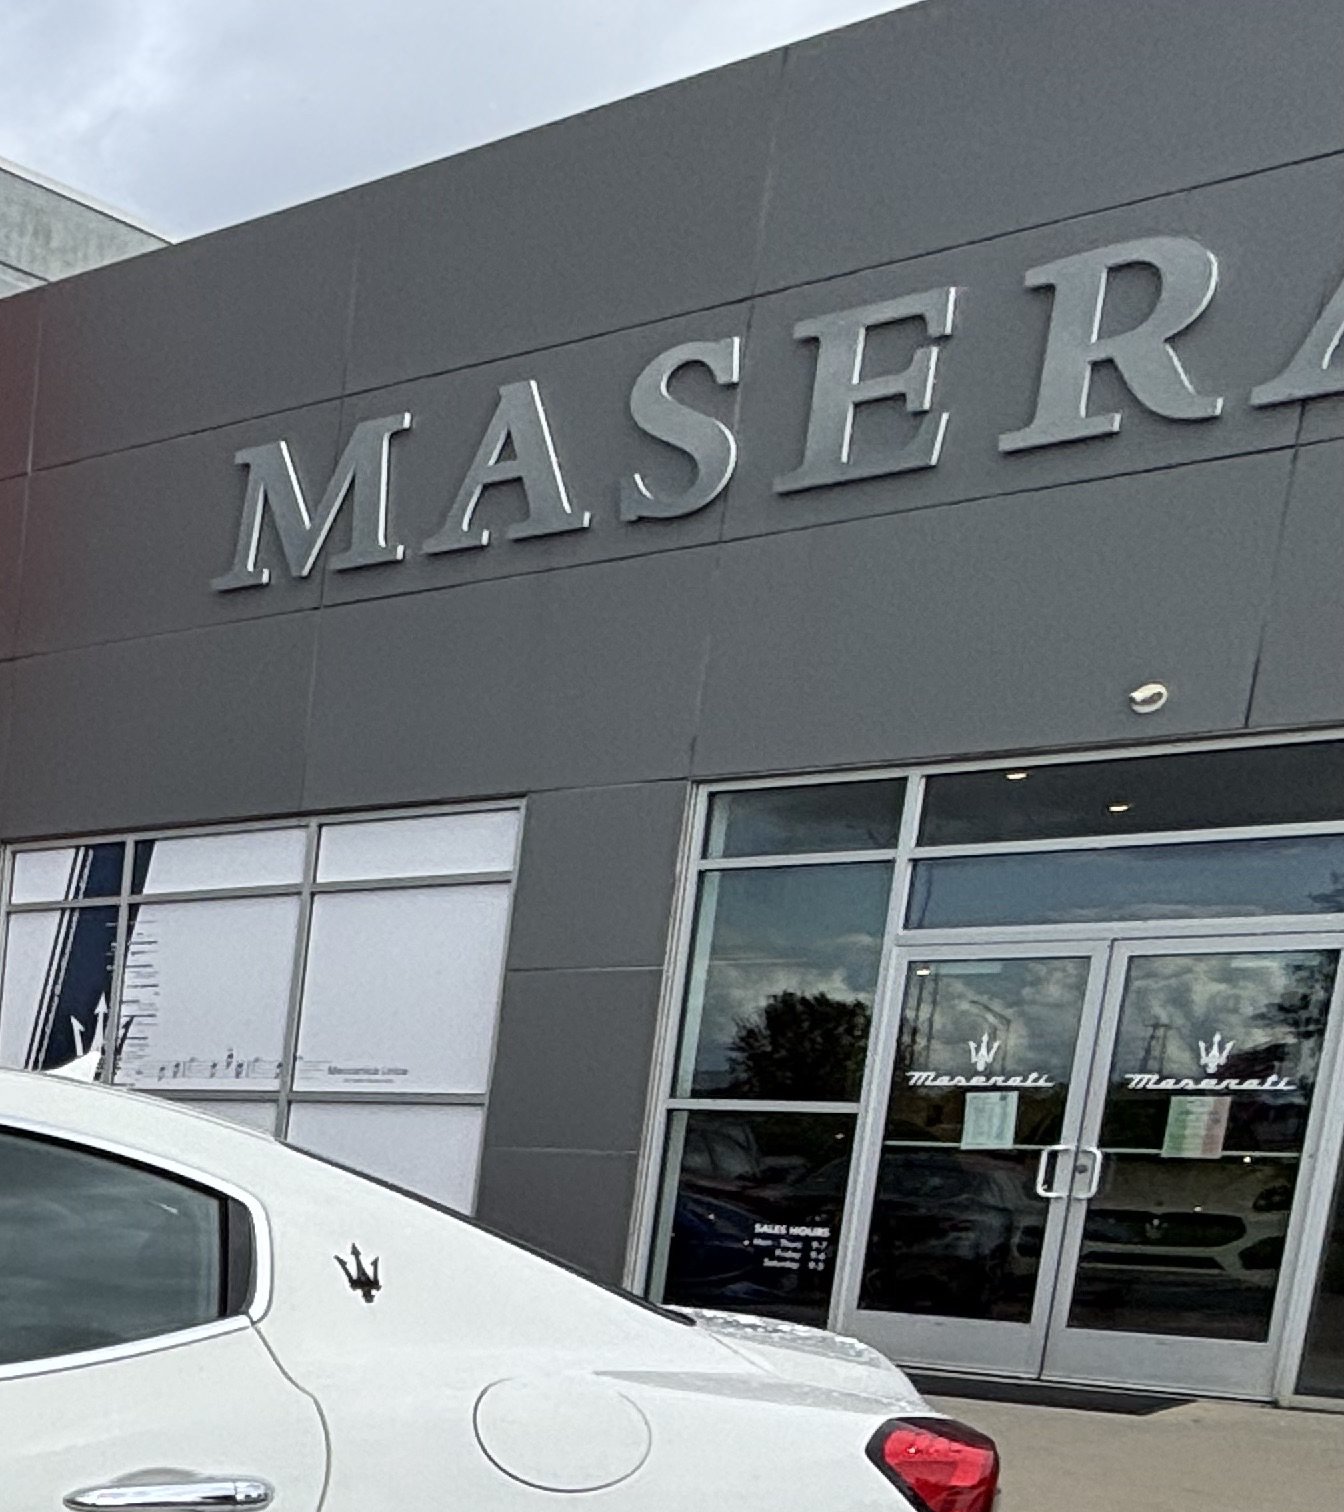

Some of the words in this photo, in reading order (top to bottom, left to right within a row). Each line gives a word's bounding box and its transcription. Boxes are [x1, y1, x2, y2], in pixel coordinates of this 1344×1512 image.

[905, 1071, 1056, 1088] Maserati
[1123, 1072, 1299, 1091] Maserati
[754, 1223, 788, 1236] SALES
[789, 1226, 831, 1238] HOURS
